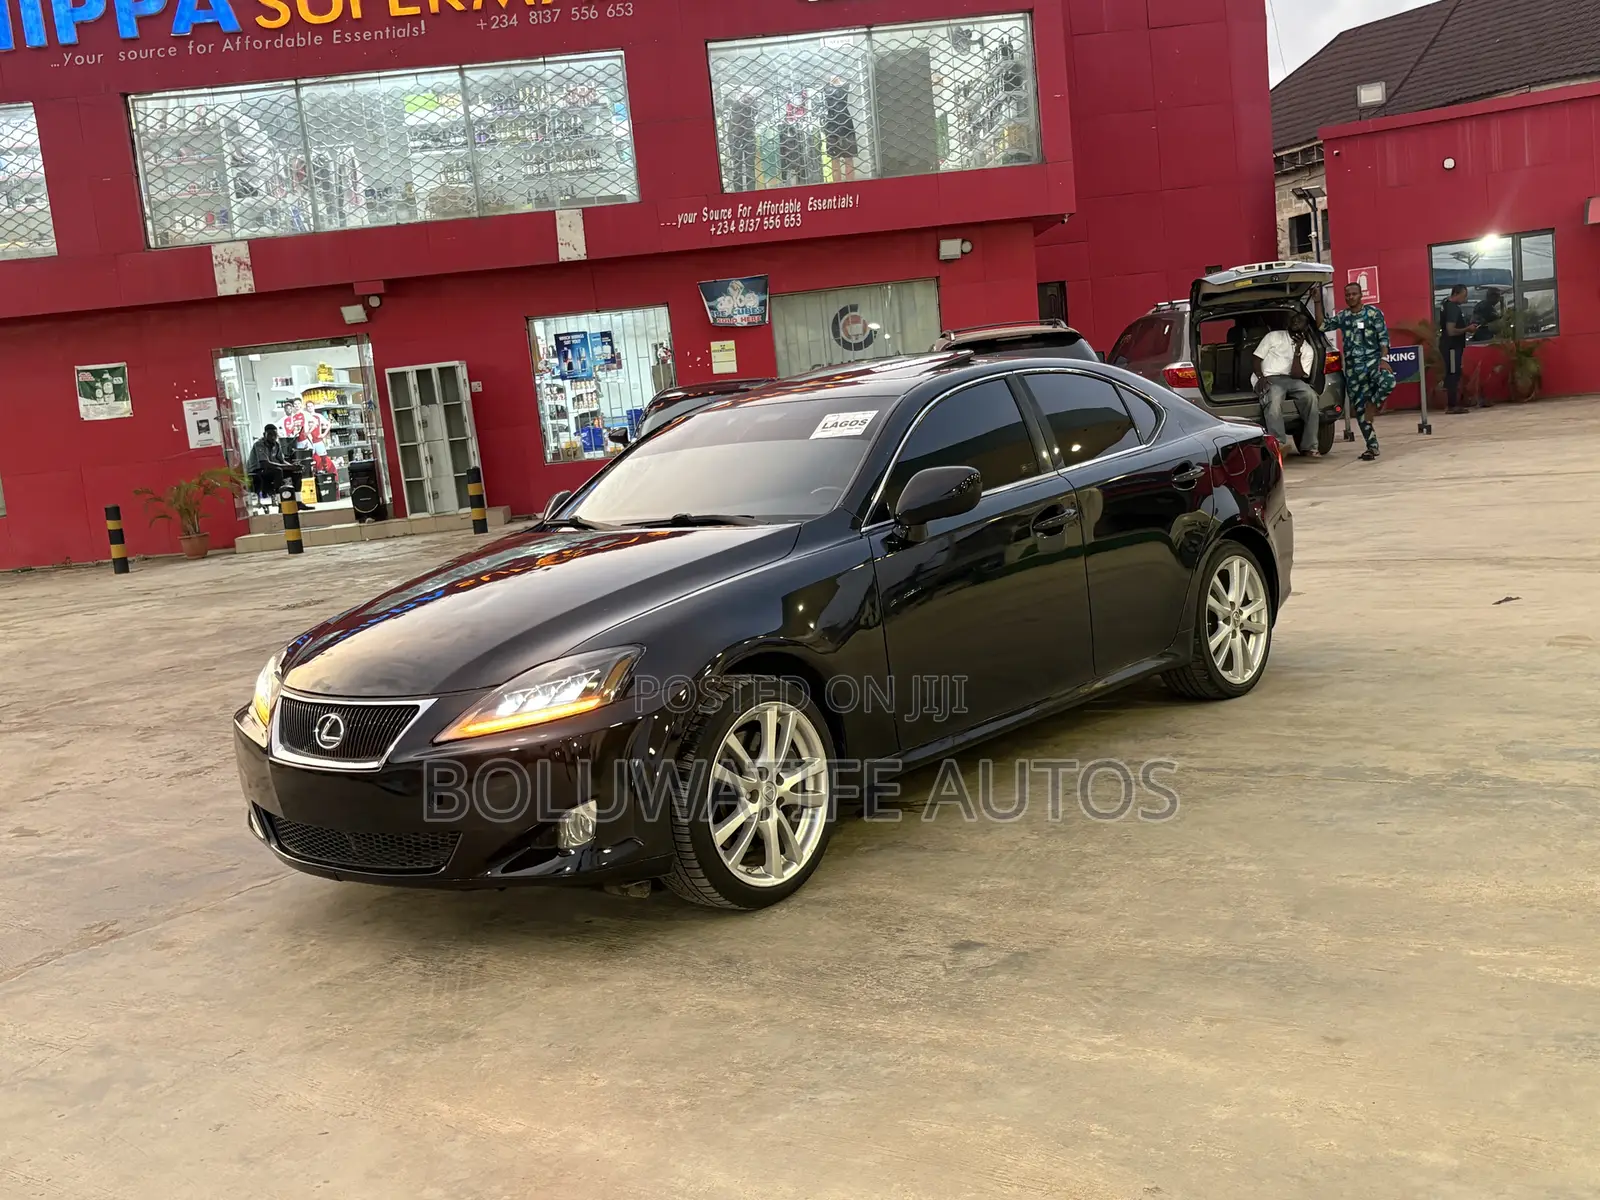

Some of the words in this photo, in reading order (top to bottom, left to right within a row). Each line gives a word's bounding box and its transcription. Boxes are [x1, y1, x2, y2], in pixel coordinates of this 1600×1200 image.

[476, 13, 519, 31] +234
[529, 8, 562, 25] 8137
[571, 5, 599, 21] 556
[606, 3, 634, 18] 653
[118, 46, 178, 62] source
[187, 39, 215, 55] for
[221, 31, 324, 53] Affordable
[332, 19, 427, 44] Essentials!
[702, 207, 732, 221] Source
[737, 203, 752, 218] For
[756, 200, 802, 216] Affordable
[710, 220, 735, 235] +234
[738, 218, 761, 232] 8137
[763, 216, 781, 230] 556
[783, 214, 801, 227] 653
[821, 419, 868, 429] LAGOS
